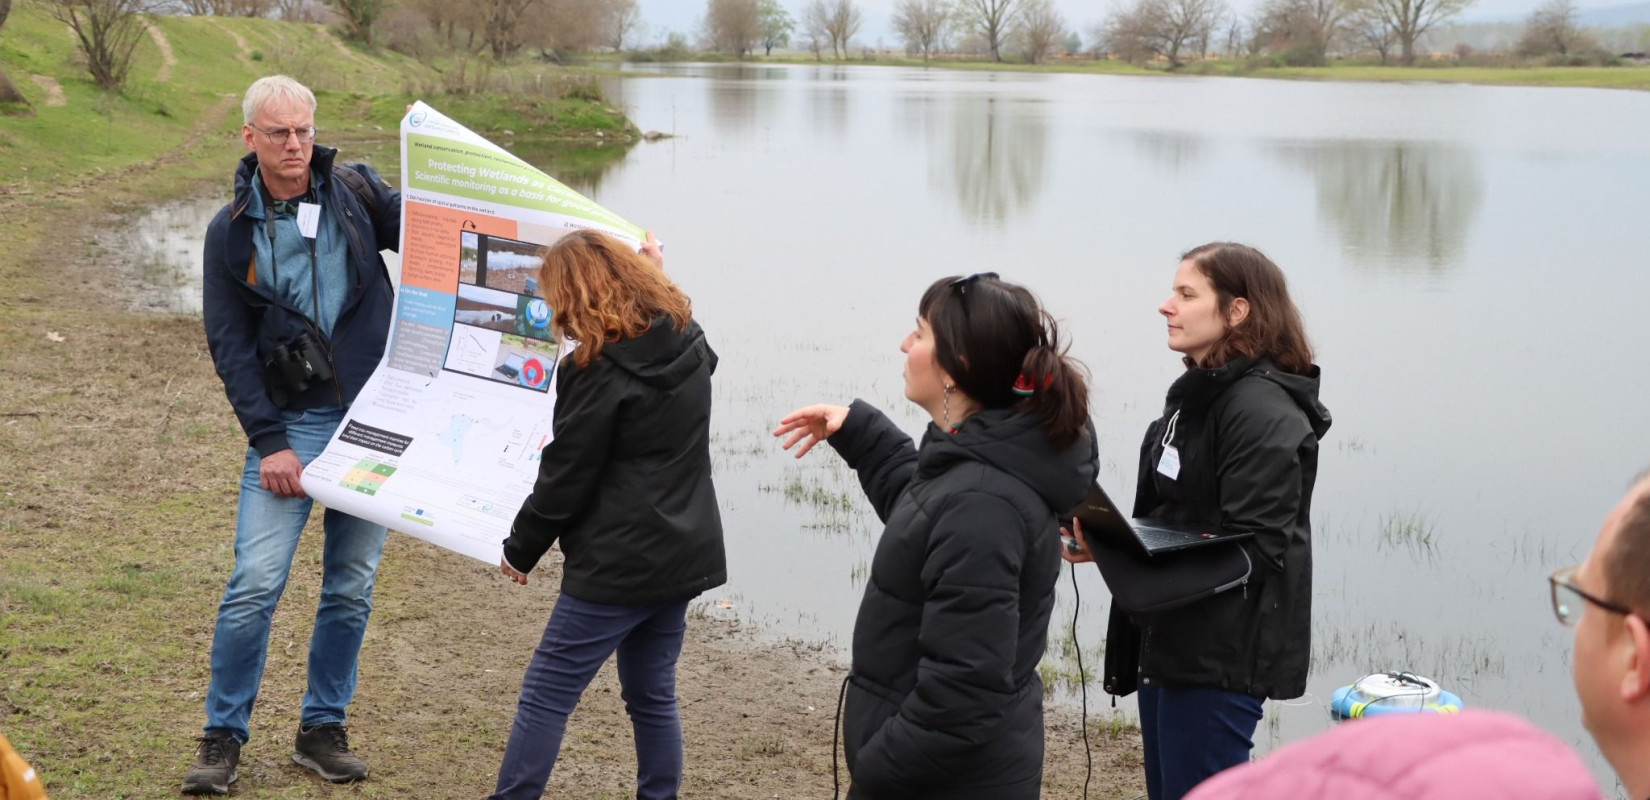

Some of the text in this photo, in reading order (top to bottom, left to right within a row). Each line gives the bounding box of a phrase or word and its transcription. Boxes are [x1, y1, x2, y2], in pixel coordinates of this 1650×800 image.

[415, 171, 450, 184] Scientific
[452, 180, 497, 194] monitoring
[520, 188, 544, 200] basis
[546, 194, 562, 204] for
[428, 159, 476, 178] Protecting
[480, 166, 528, 184] Wetlands
[530, 180, 544, 188] as
